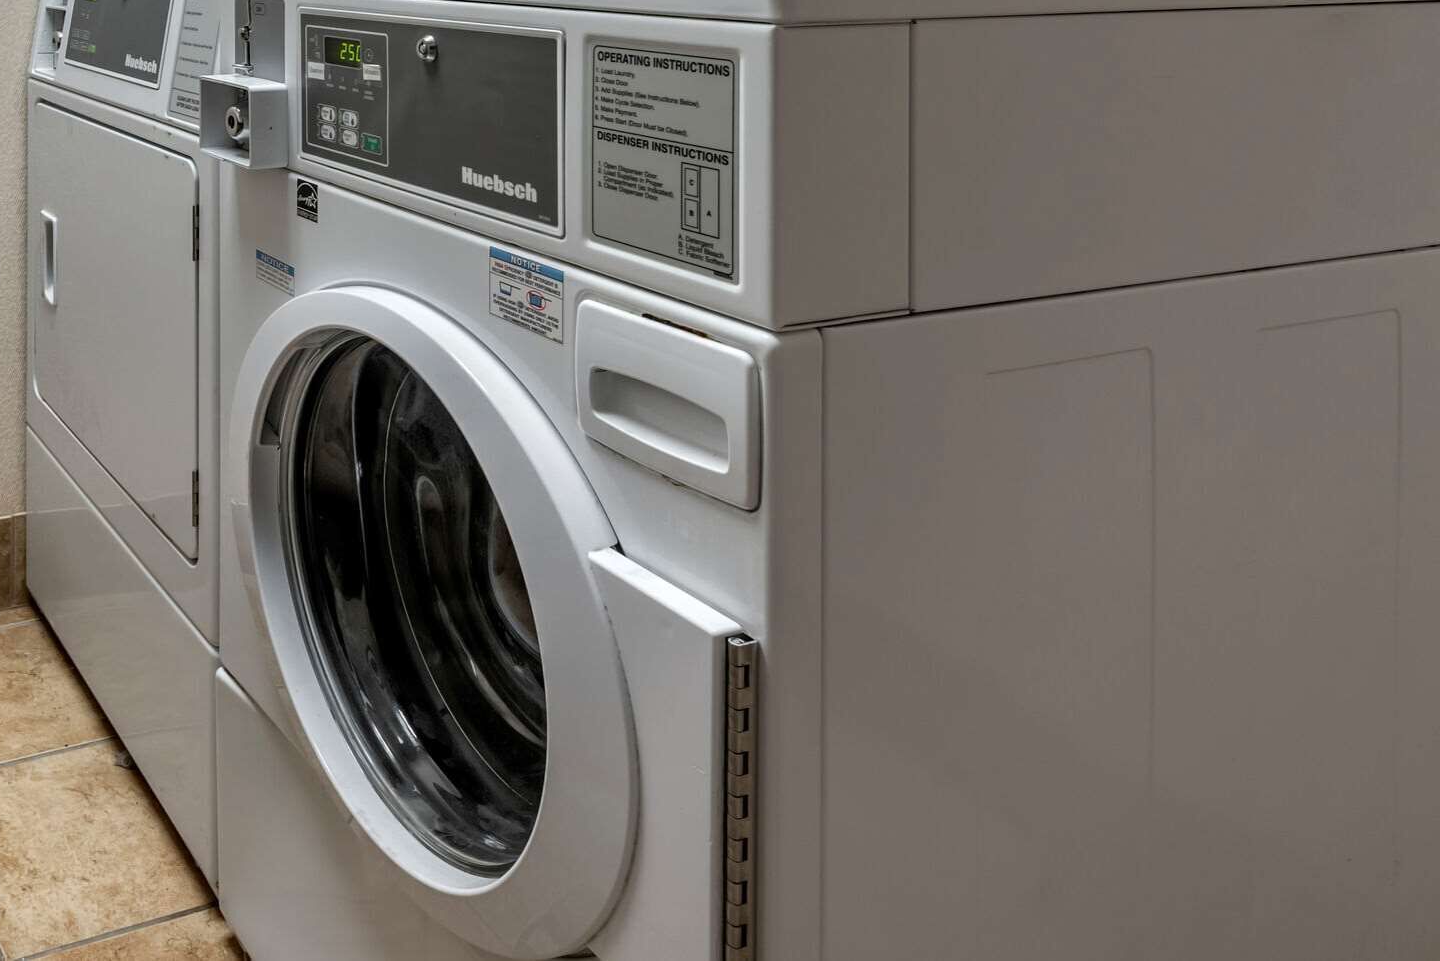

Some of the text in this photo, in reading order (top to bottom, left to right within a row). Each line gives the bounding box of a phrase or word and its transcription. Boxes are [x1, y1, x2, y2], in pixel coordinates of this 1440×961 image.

[124, 53, 157, 74] Huebsch
[597, 51, 730, 77] OPERATING INSTRUCTIONS
[597, 130, 729, 166] DISPENSER INSTRUCTIONS
[462, 165, 537, 203] Huebsch
[261, 253, 289, 271] NOTICE
[511, 254, 541, 271] NOTICE
